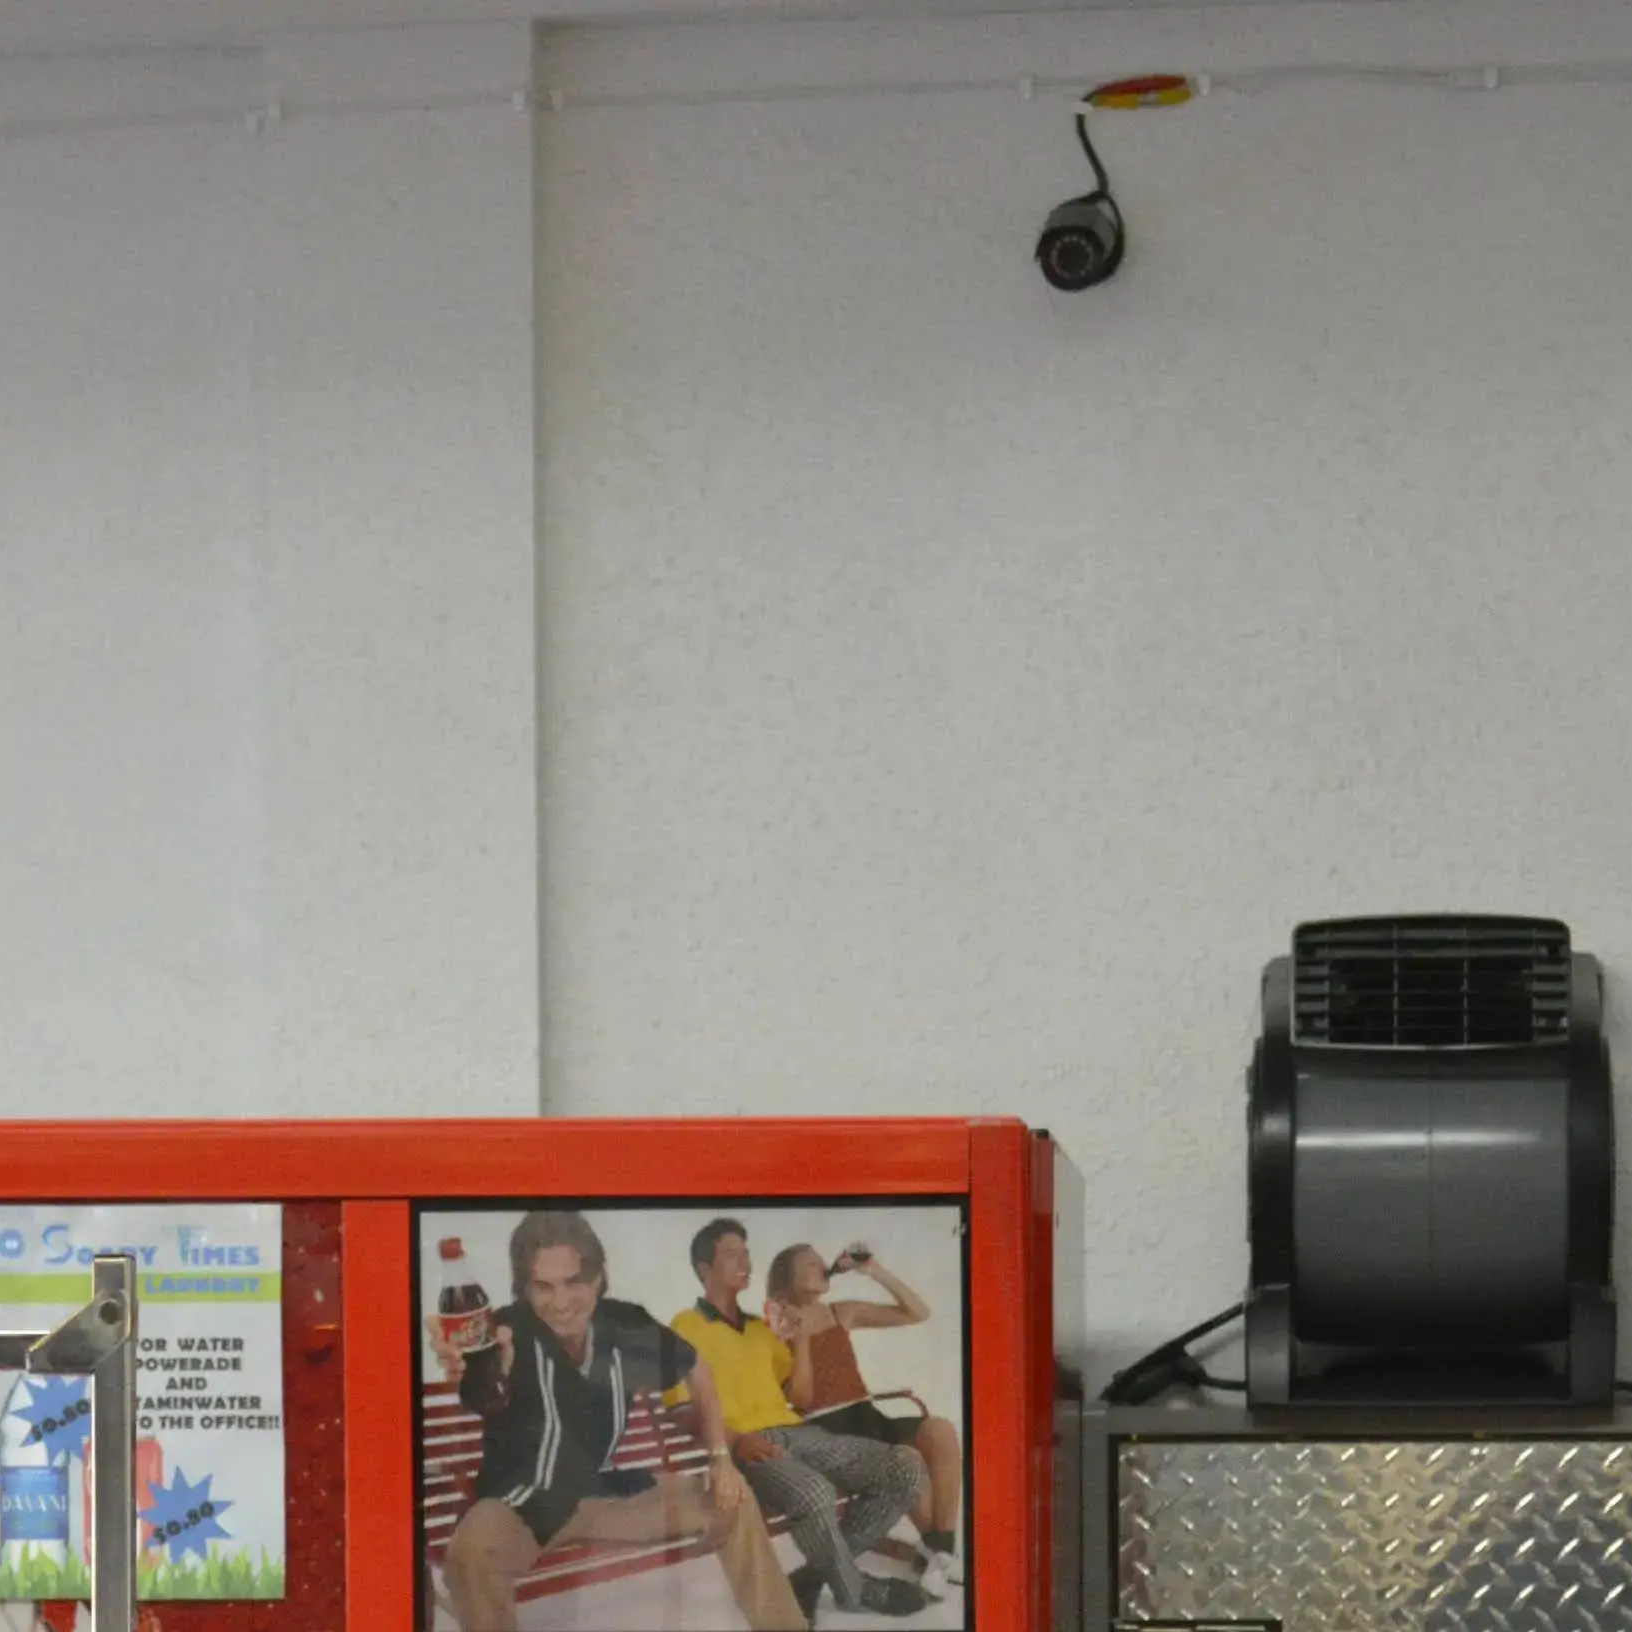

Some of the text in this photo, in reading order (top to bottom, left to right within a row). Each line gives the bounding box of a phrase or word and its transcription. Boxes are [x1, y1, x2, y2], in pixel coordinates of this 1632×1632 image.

[137, 1338, 244, 1351] OR WATER
[165, 1378, 207, 1390] AND
[135, 1416, 280, 1430] O THE OFFICE!!
